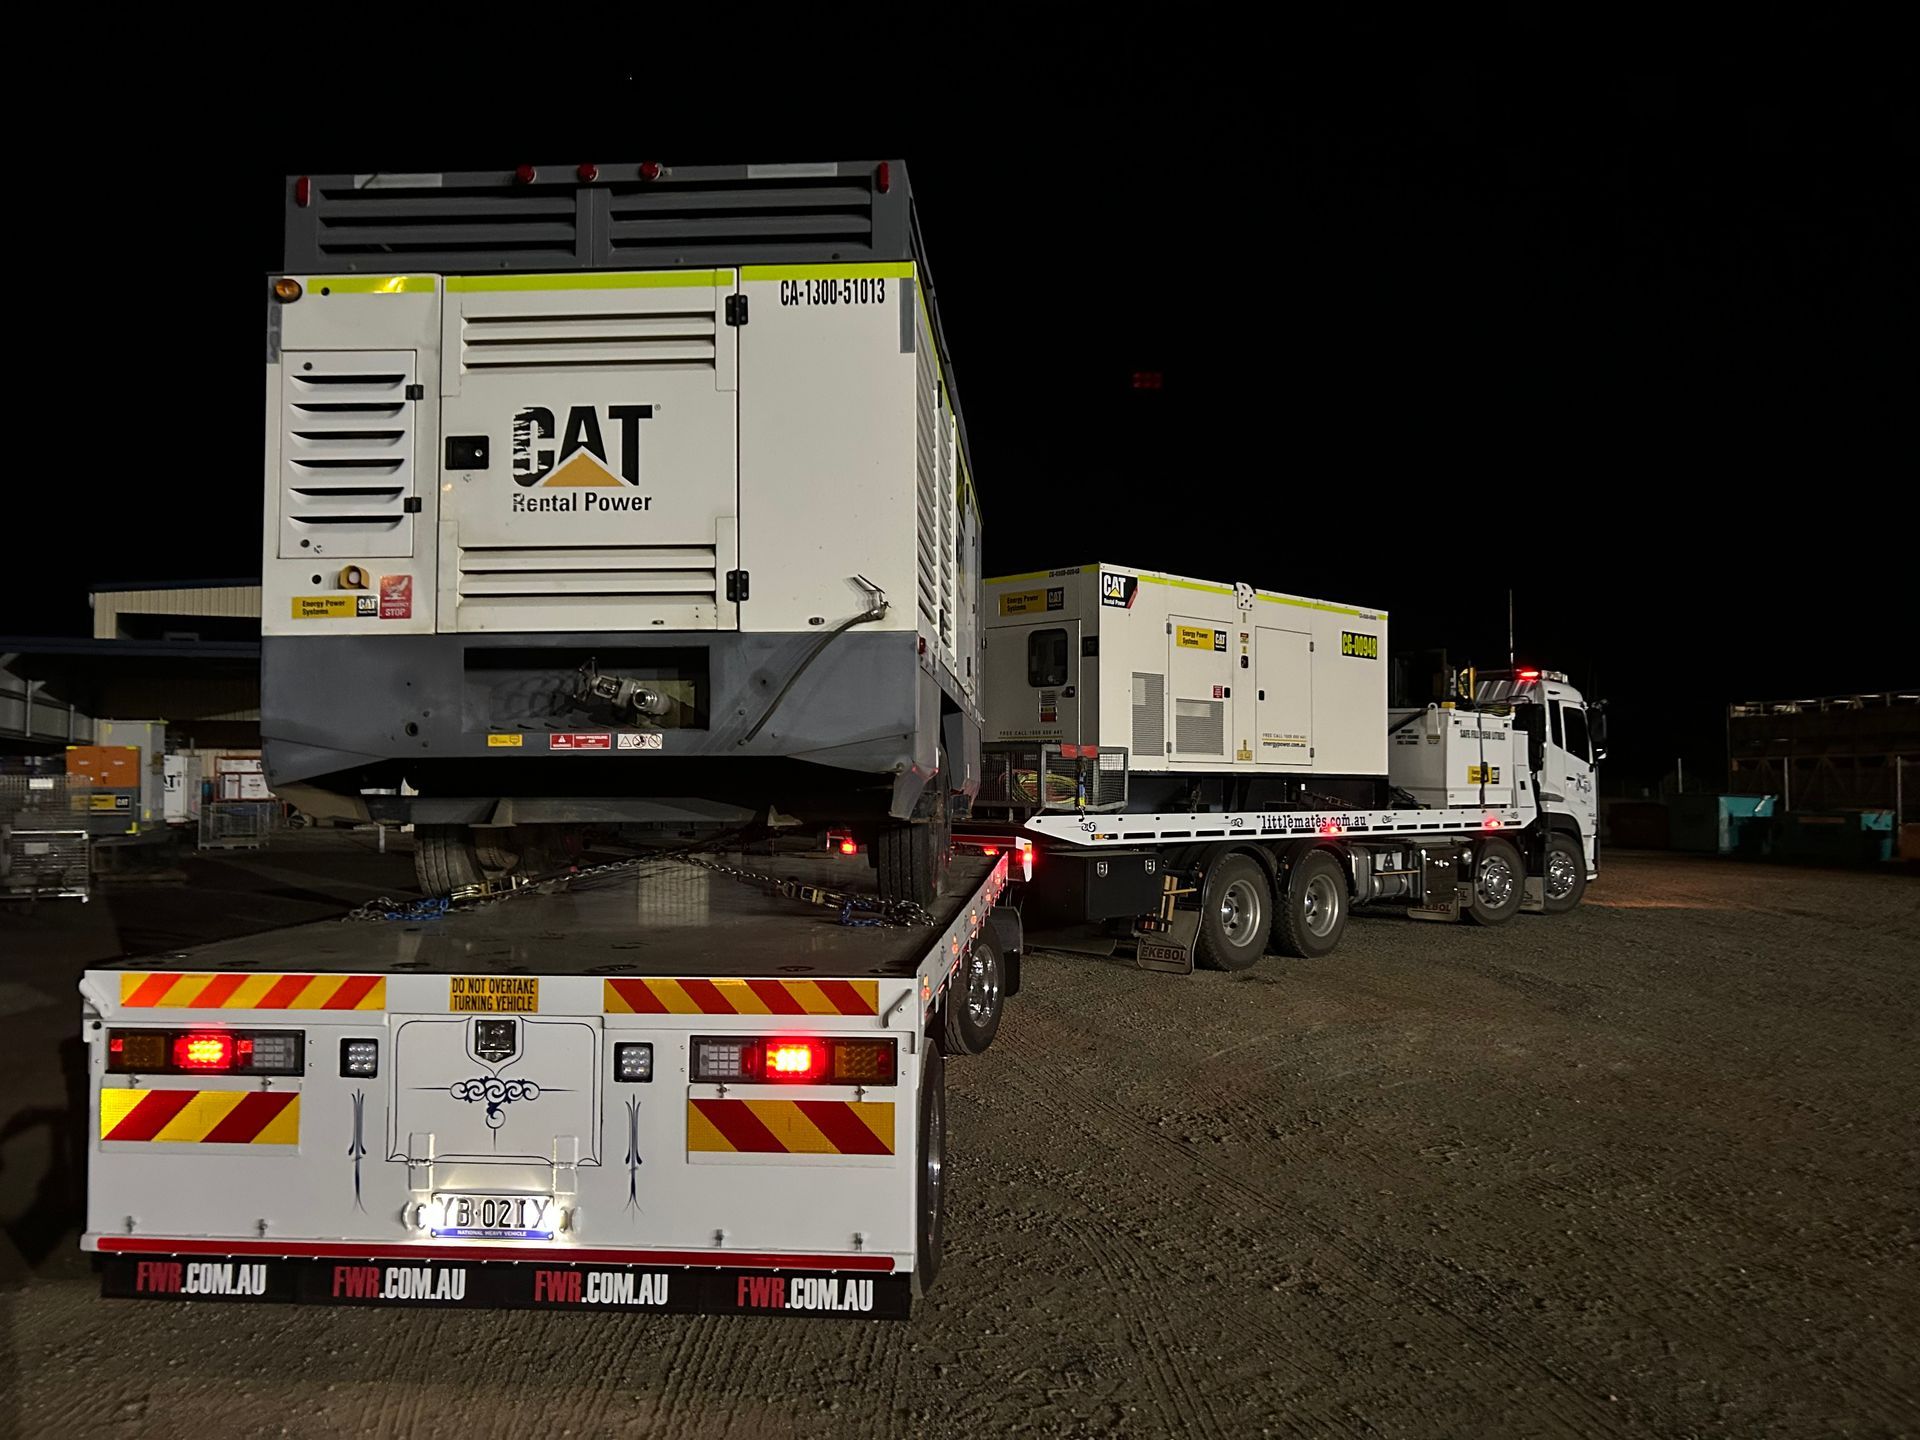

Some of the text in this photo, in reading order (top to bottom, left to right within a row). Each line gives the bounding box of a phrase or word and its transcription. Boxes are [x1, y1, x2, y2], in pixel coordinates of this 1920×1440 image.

[780, 278, 885, 306] CA-1300-51013
[513, 405, 653, 487] CAT
[513, 492, 652, 512] Rental Power
[1103, 574, 1127, 599] CAT
[302, 599, 346, 608] Energy Power
[358, 598, 377, 609] CAT
[1007, 594, 1039, 605] Energy Power
[1049, 590, 1063, 603] CAT
[302, 607, 329, 616] Systems
[385, 608, 406, 616] STOP
[1007, 604, 1027, 613] Systems
[1182, 629, 1209, 639] Energy Power
[1182, 637, 1199, 646] Systems
[1343, 633, 1377, 658] CG-00948
[1262, 814, 1366, 829] littlemates.com.au
[1141, 946, 1186, 960] EKEBOL
[452, 978, 535, 995] DO NOT OVERTAKE
[454, 995, 533, 1012] TURNING VEHICLE
[136, 1261, 267, 1295] FWR.COM.AU
[333, 1266, 466, 1300] FWR.COM.AU
[534, 1270, 668, 1305] FWR.COM.AU
[737, 1276, 873, 1311] FWR.COM.AU
